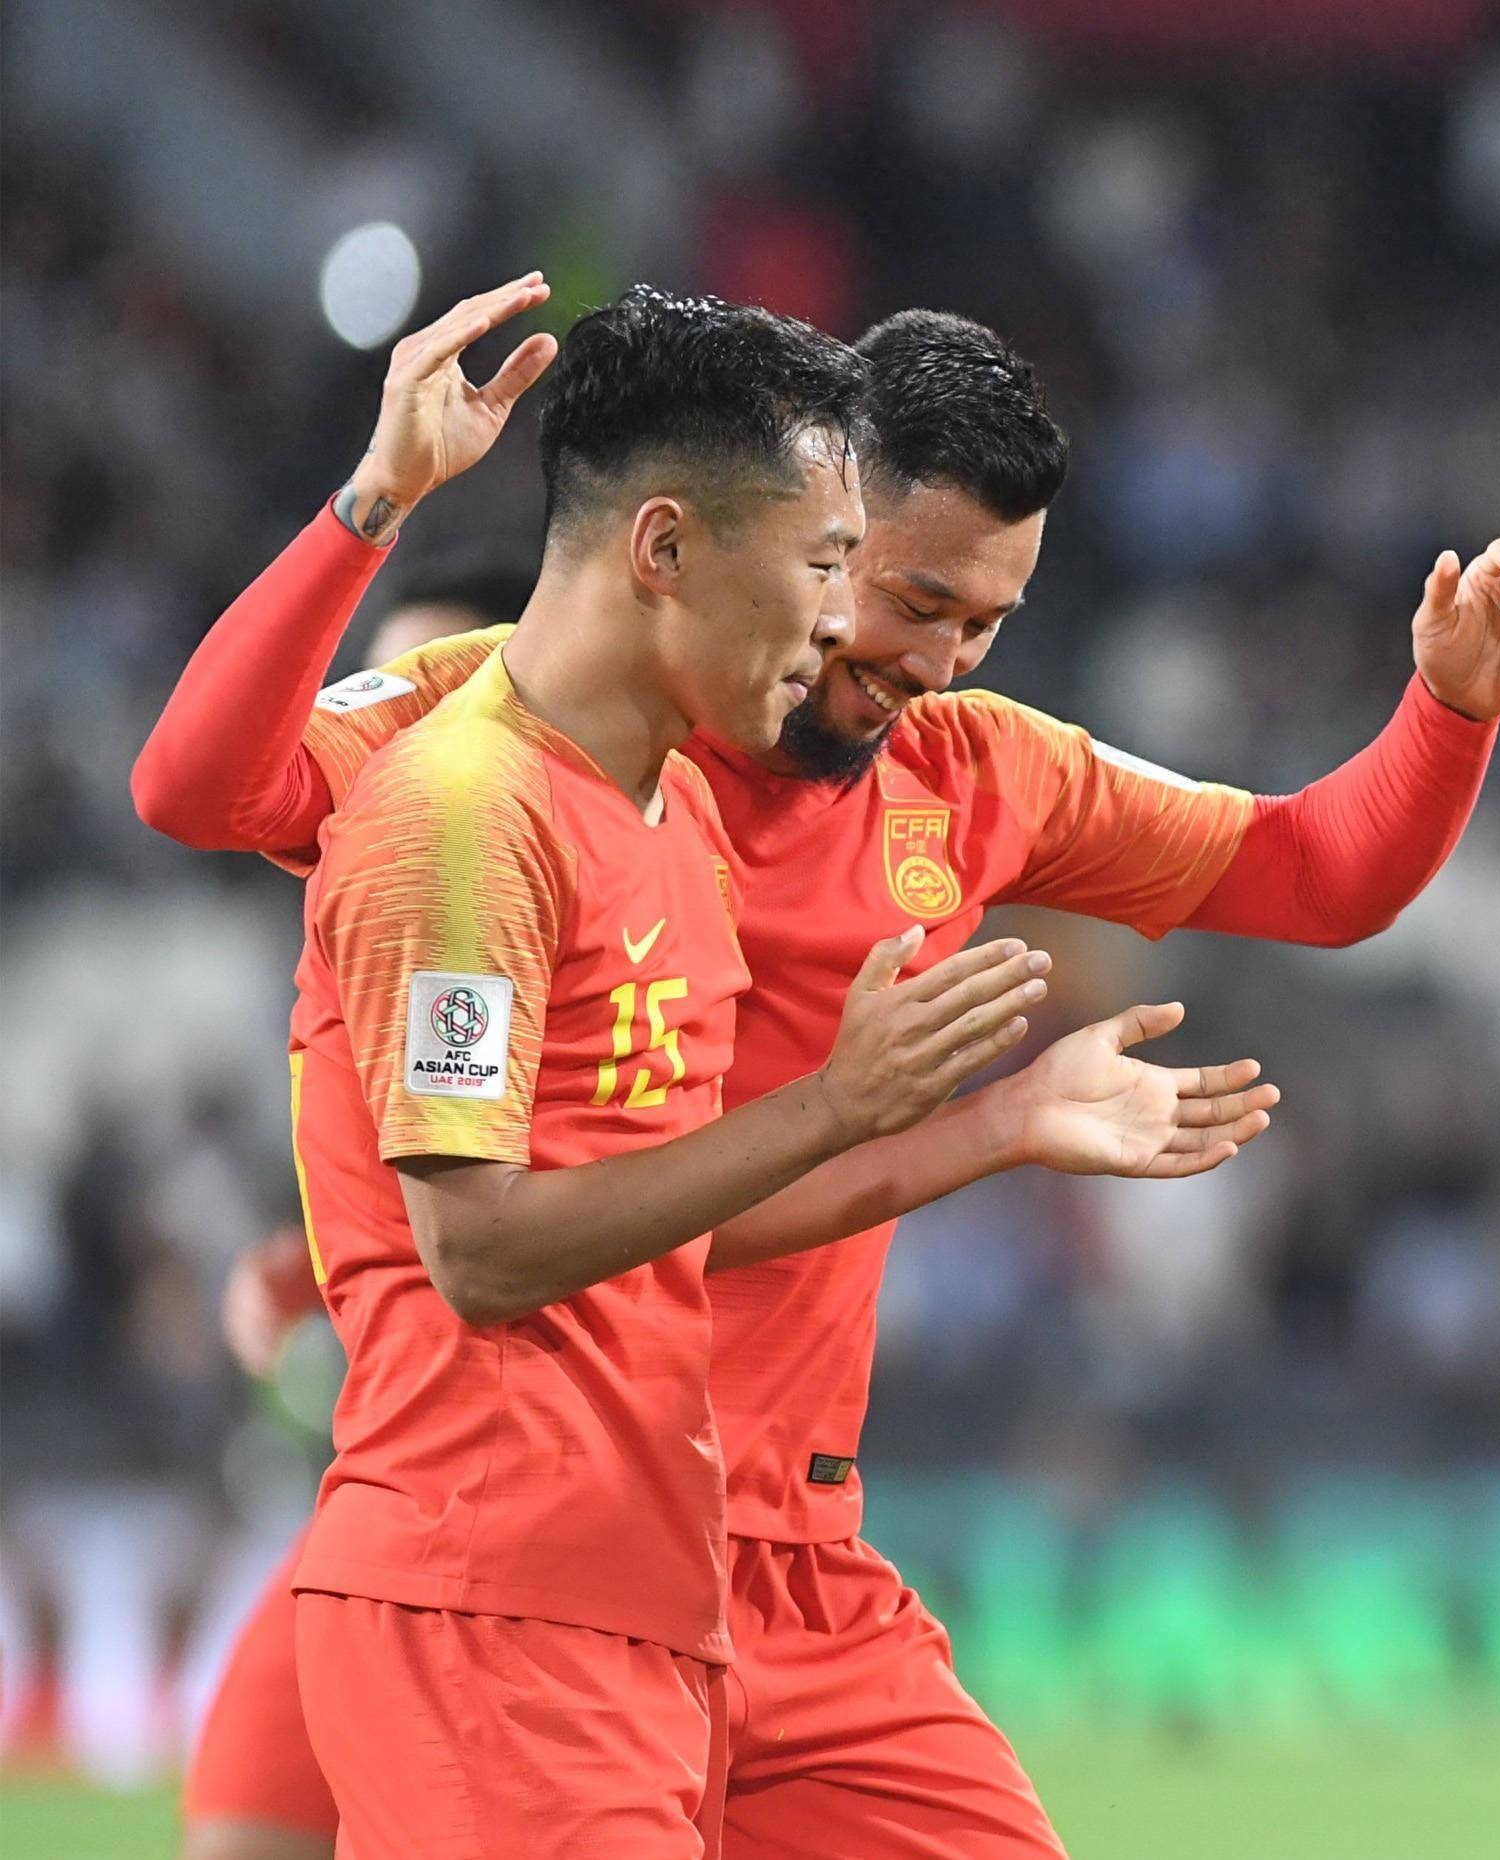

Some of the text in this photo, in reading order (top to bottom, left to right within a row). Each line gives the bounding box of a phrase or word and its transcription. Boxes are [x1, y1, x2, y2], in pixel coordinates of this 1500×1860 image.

[890, 817, 943, 839] CFA
[589, 976, 689, 1109] 15
[445, 1050, 471, 1062] AFC
[413, 1060, 499, 1078] ASIAN CUP
[430, 1075, 454, 1085] UAE
